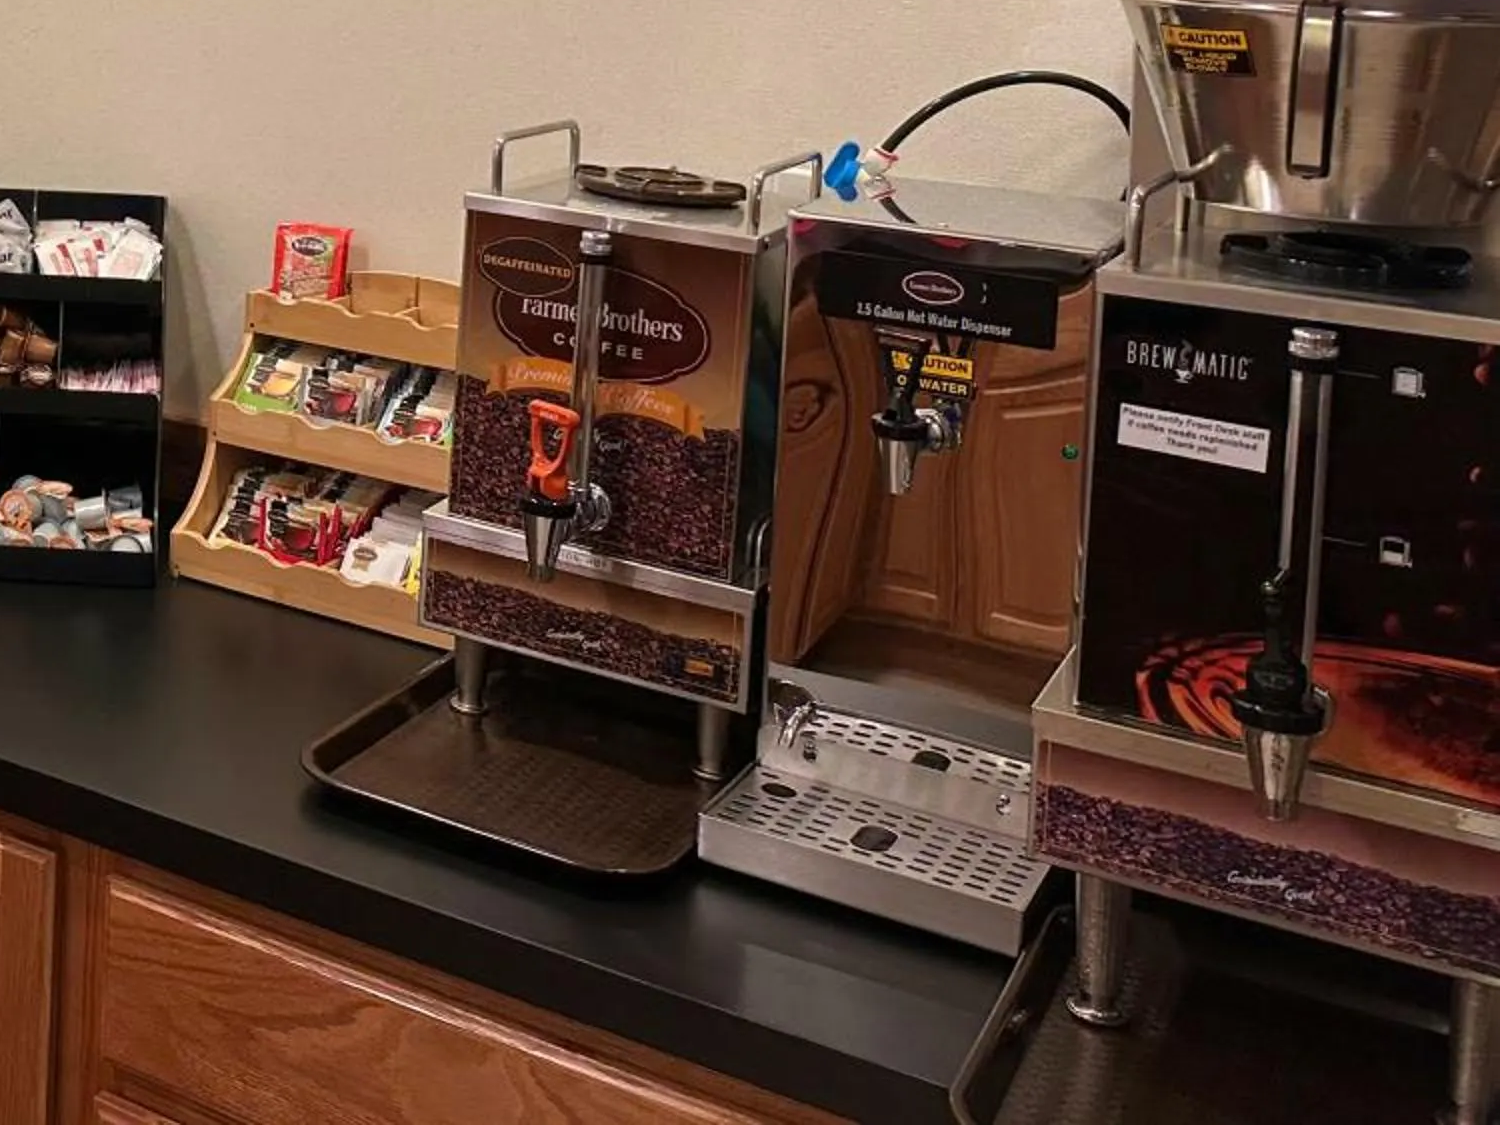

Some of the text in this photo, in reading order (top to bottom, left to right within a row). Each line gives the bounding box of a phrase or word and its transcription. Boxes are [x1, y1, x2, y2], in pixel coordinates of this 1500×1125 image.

[1179, 32, 1241, 46] CAUTION
[483, 254, 571, 279] DECAFFEINATED
[856, 302, 1013, 337] 1.5 Gallon Hot Water Dispenser
[553, 332, 644, 361] COFEE
[1127, 340, 1249, 380] BREW MATIC
[919, 378, 968, 396] WATER
[1123, 406, 1155, 420] Please
